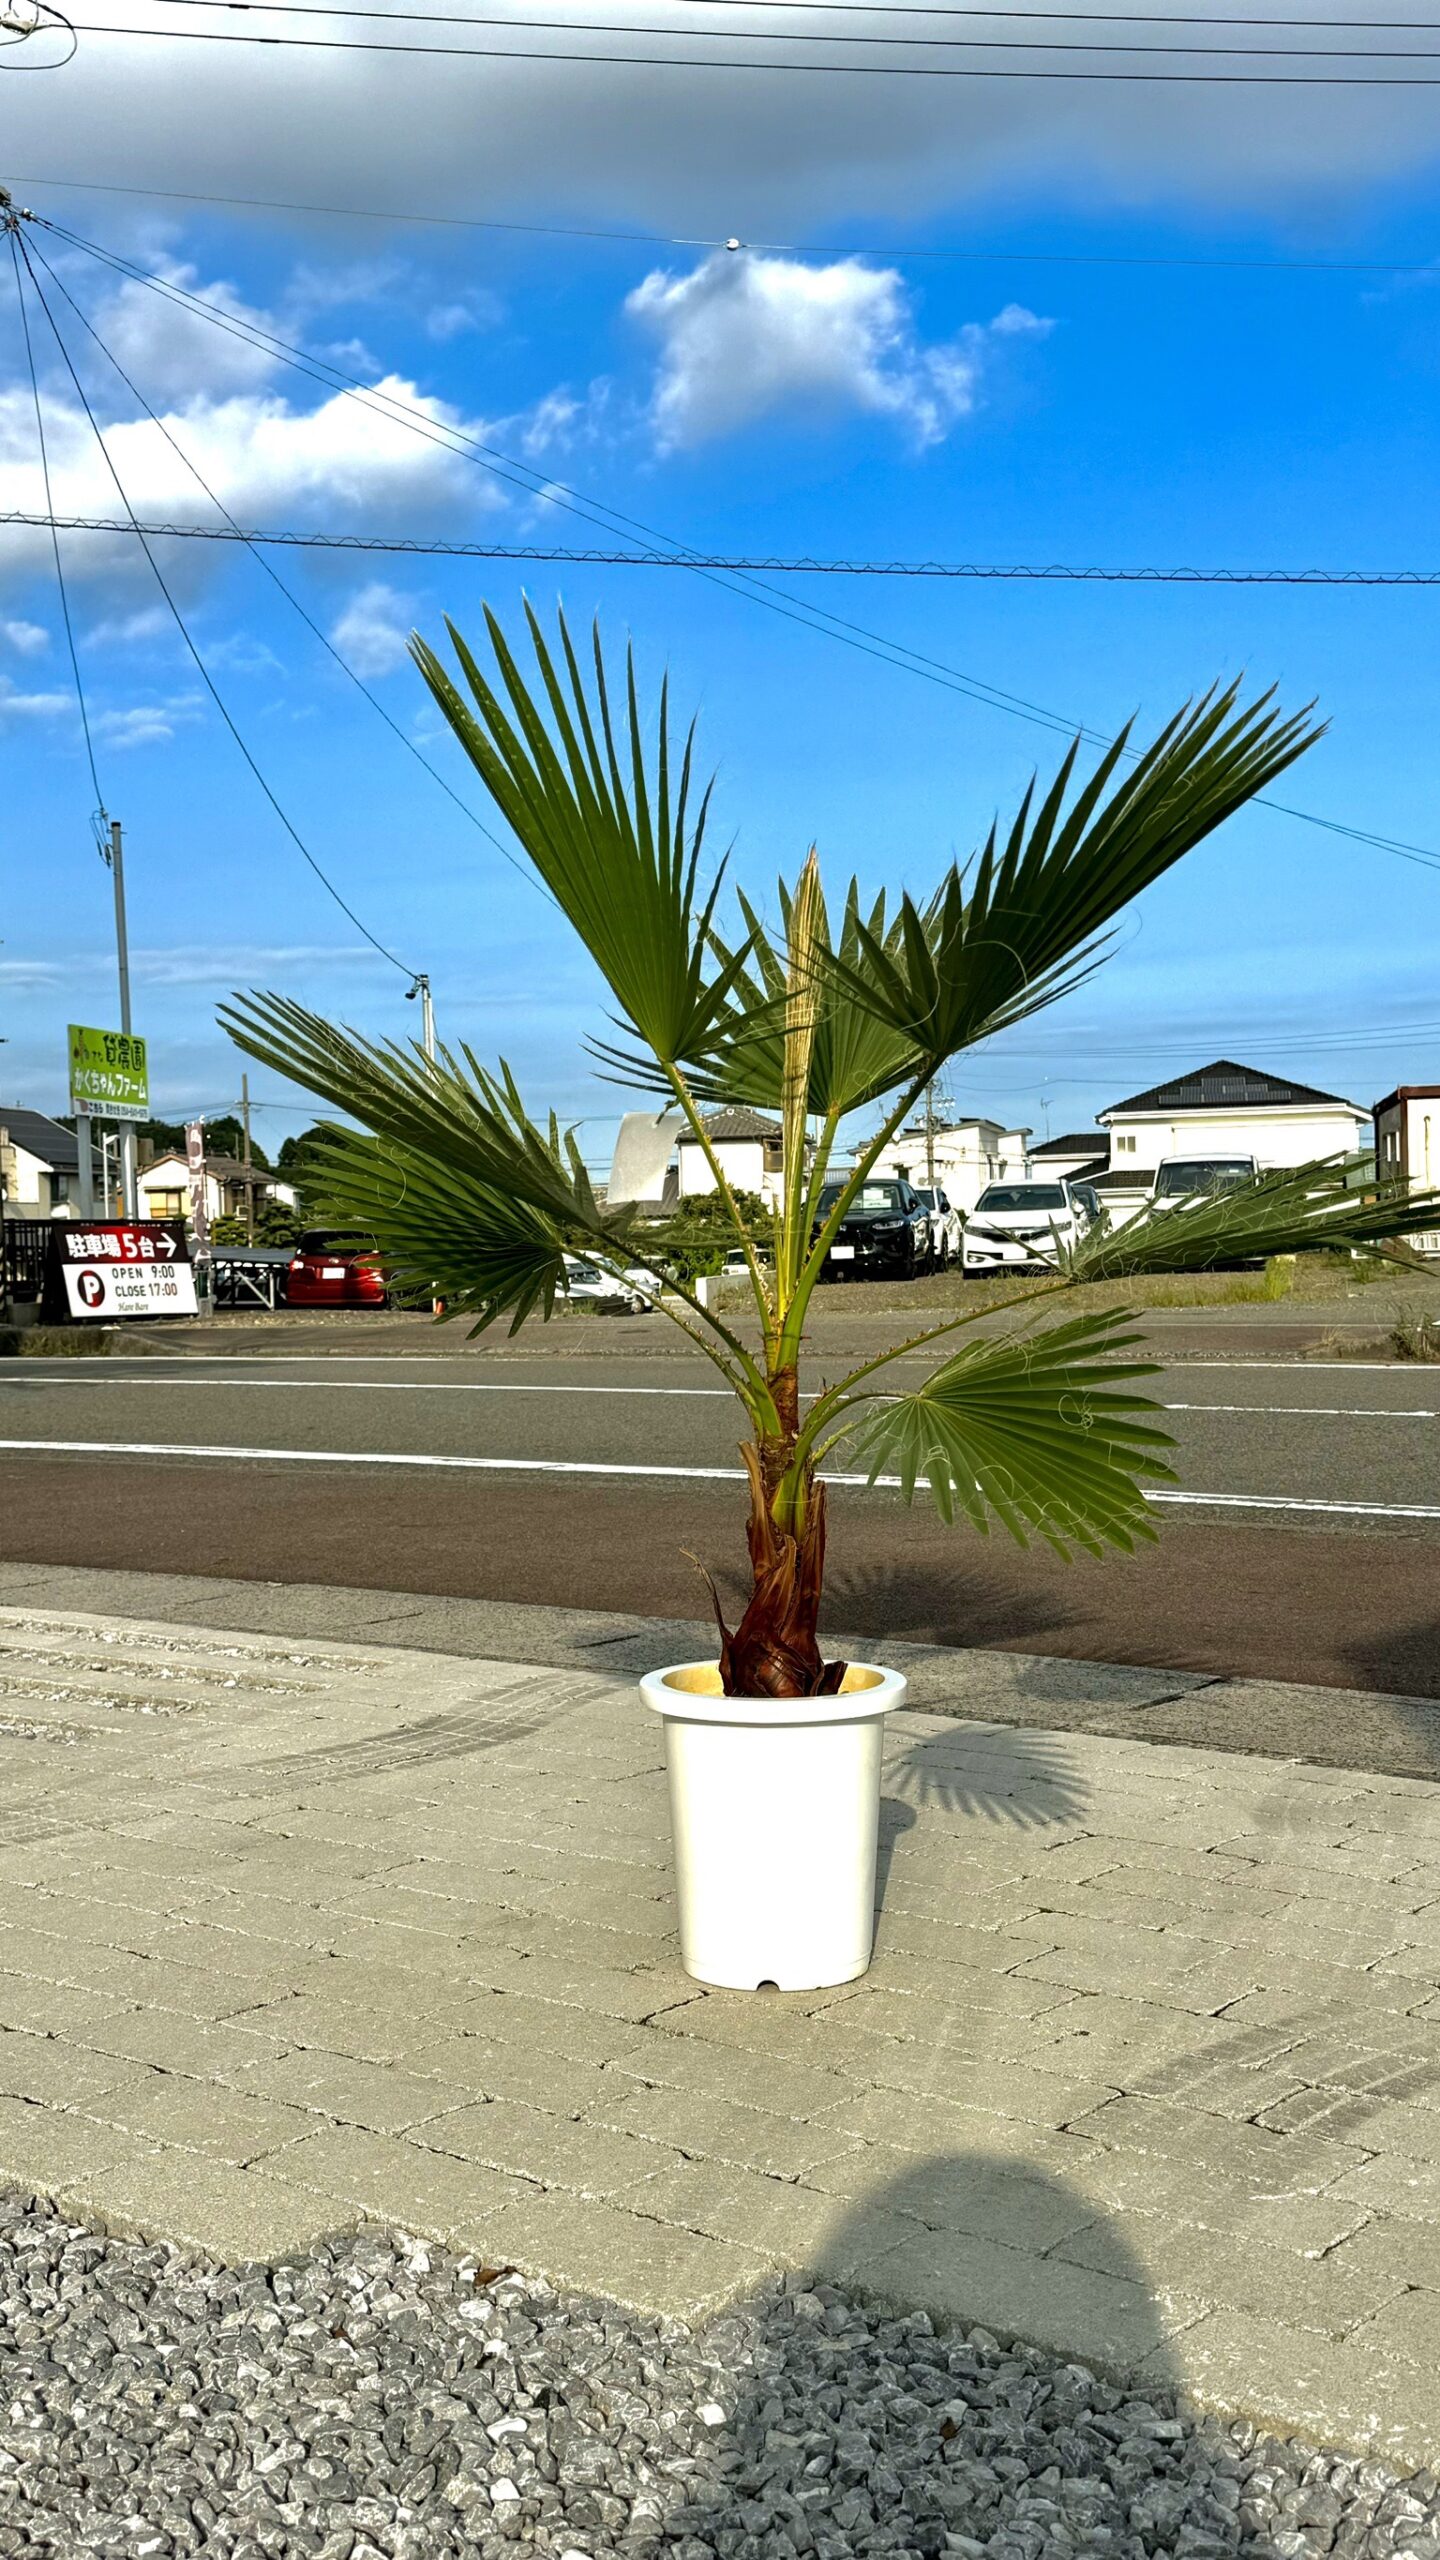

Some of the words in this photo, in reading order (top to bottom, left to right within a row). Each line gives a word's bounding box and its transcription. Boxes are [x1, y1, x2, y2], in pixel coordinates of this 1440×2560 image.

[65, 1233, 155, 1258] 駐車場5台
[112, 1267, 143, 1279] OPEN
[151, 1265, 175, 1279] 9:00
[83, 1275, 100, 1304] P
[115, 1285, 146, 1297] CLOSE
[148, 1283, 178, 1296] 17:00
